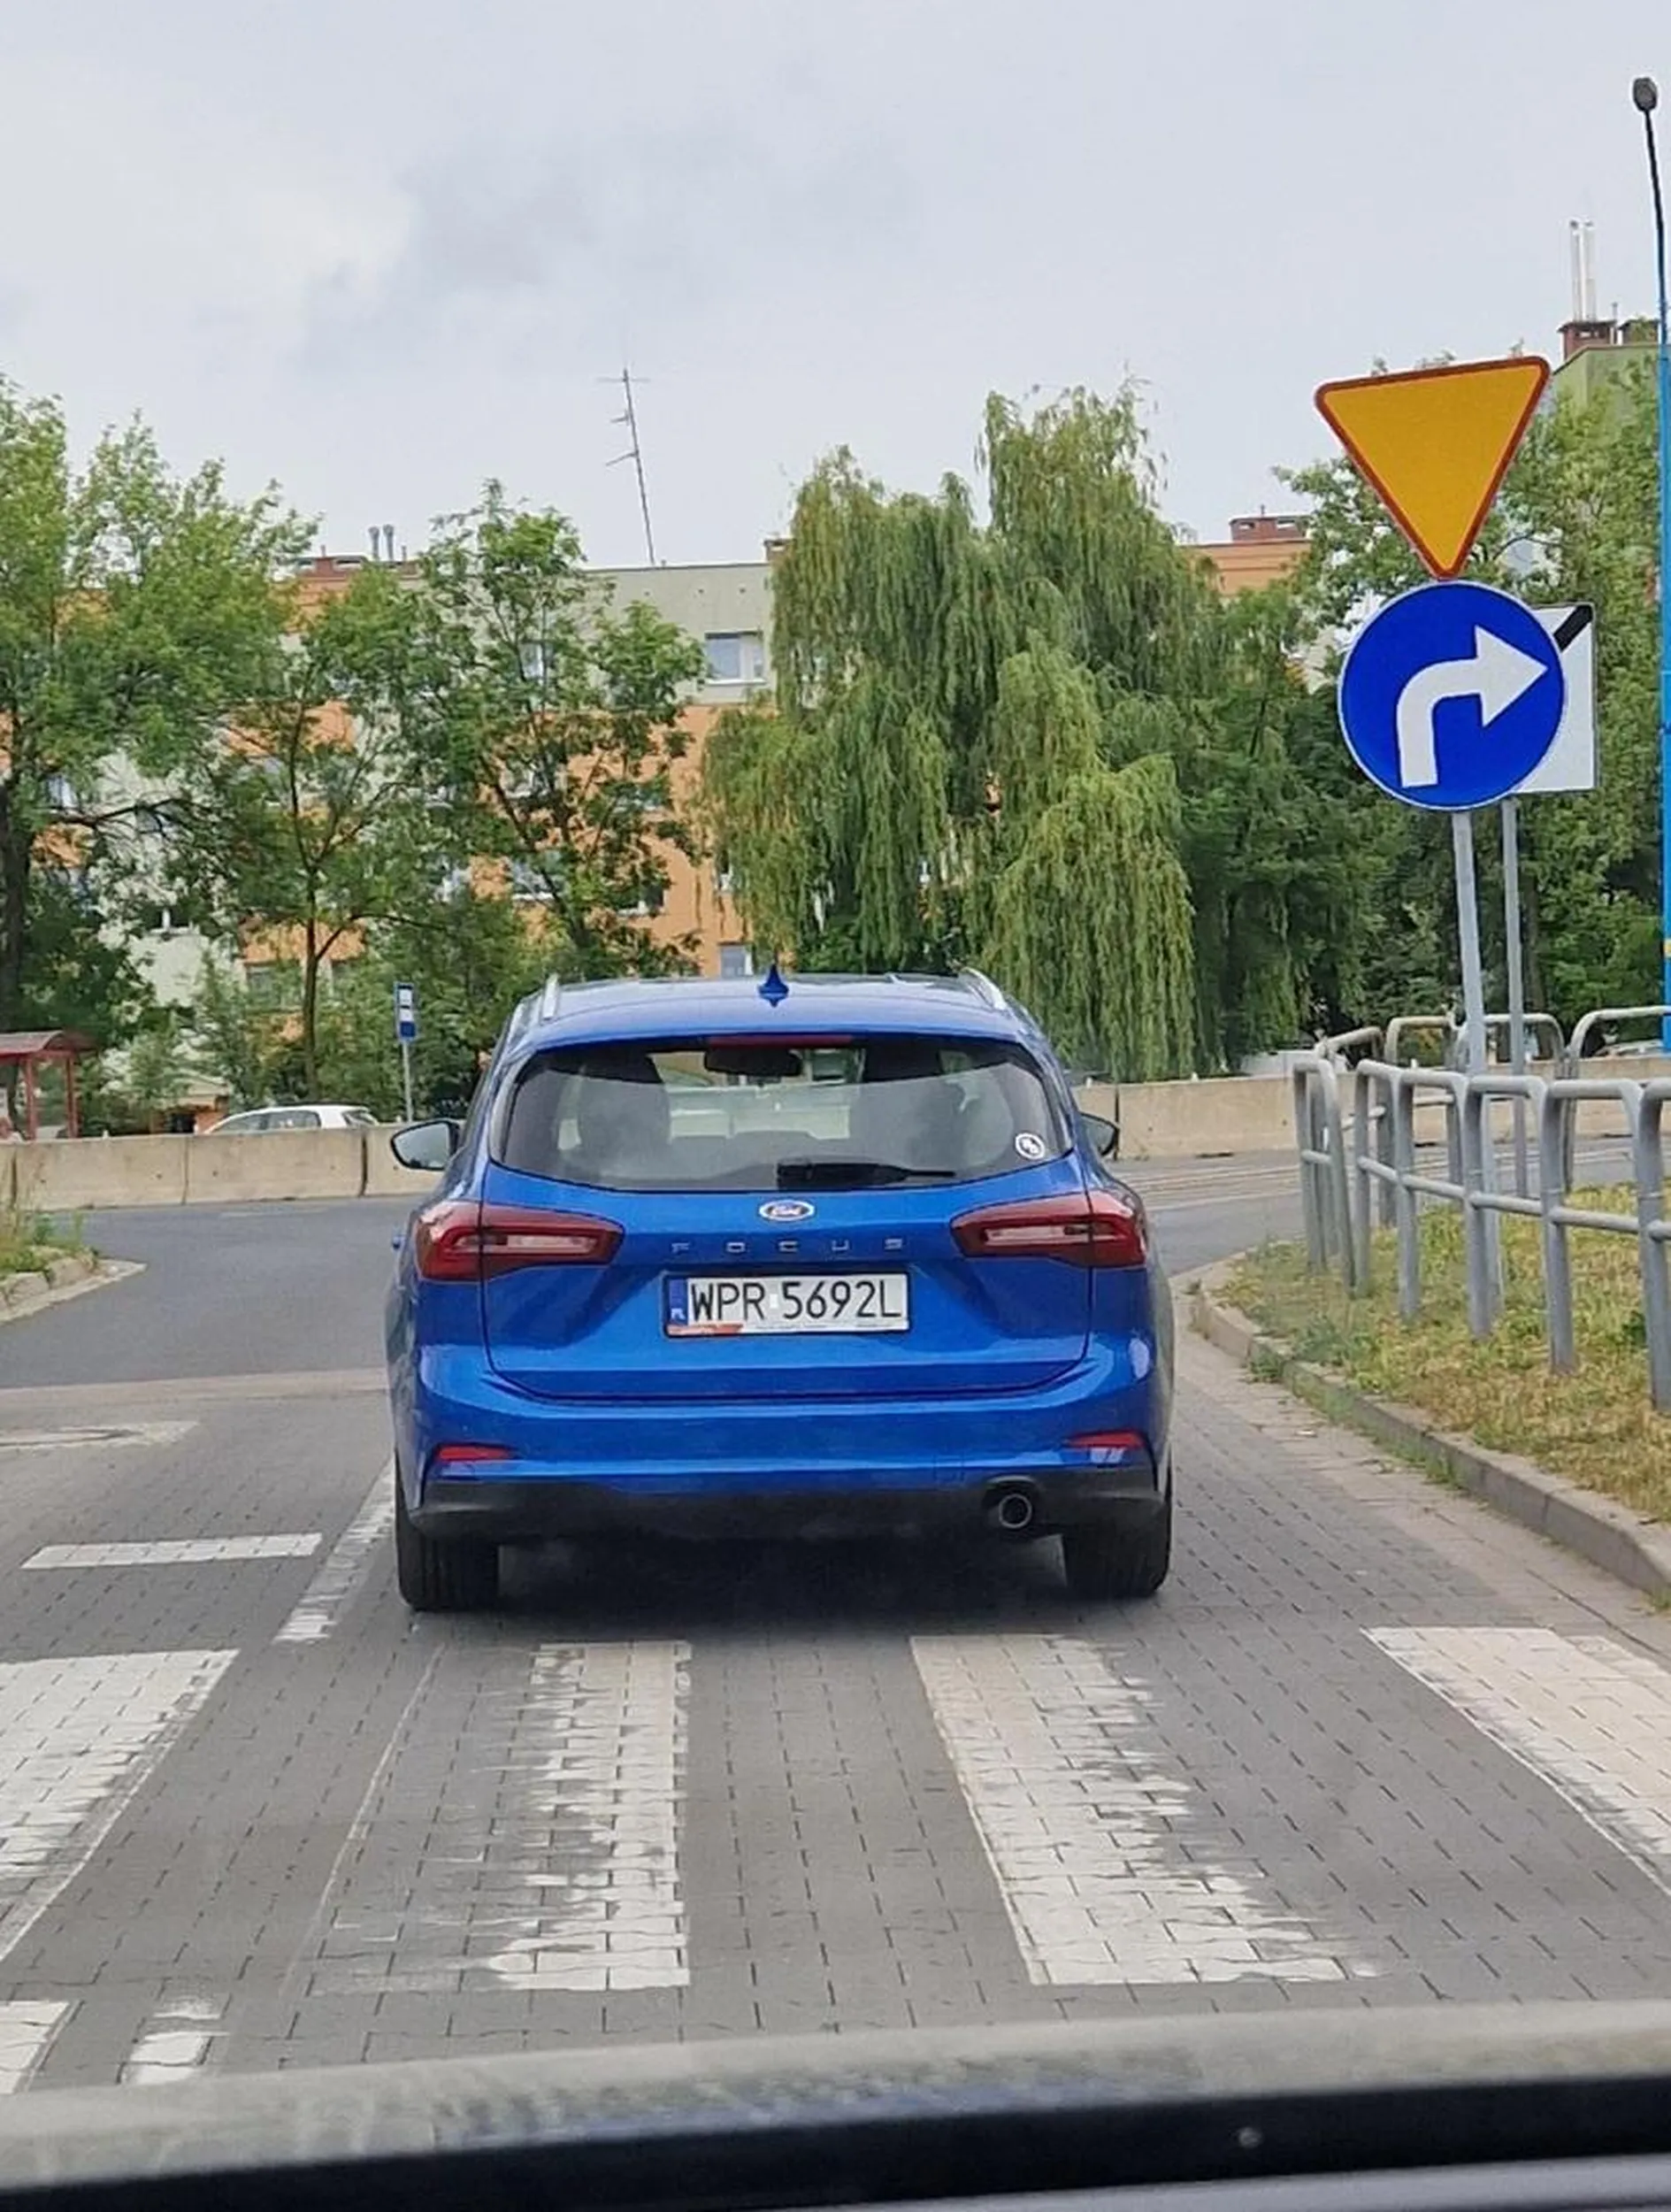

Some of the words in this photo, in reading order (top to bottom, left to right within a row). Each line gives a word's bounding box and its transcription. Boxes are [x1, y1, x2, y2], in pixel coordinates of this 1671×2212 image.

[671, 1239, 903, 1255] FOCUS
[691, 1282, 766, 1321] WPR
[783, 1279, 902, 1319] 5692L
